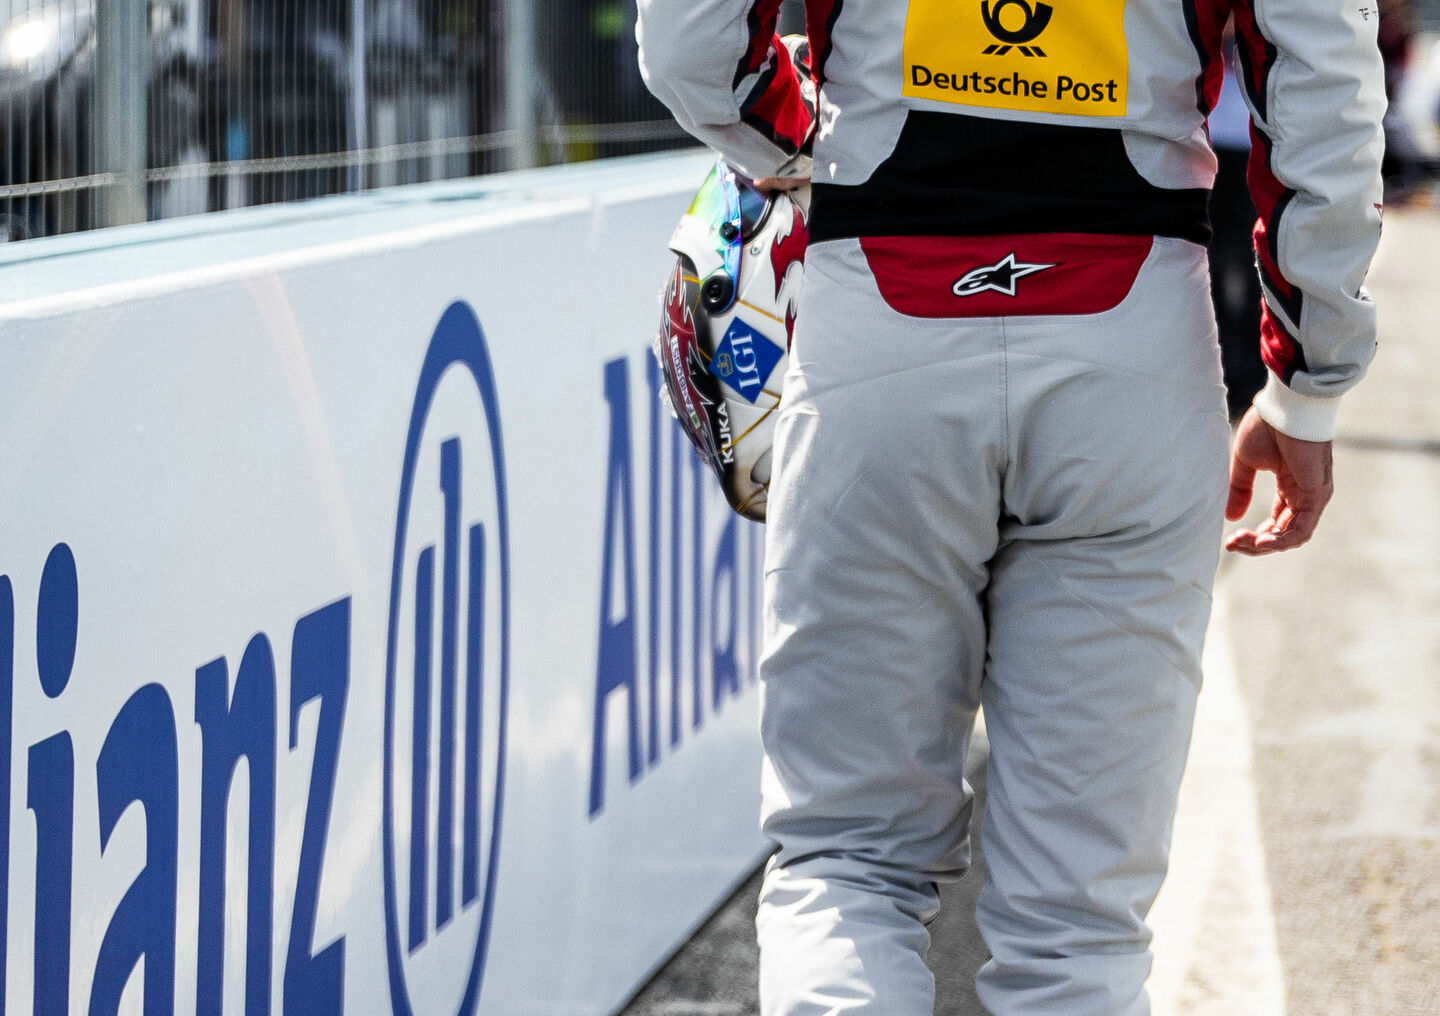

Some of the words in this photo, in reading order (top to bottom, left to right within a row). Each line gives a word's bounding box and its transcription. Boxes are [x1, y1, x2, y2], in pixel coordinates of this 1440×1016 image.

[911, 65, 1048, 99] Deutsche
[1056, 75, 1118, 103] Post
[729, 329, 761, 390] LGT
[717, 401, 735, 465] KUKA
